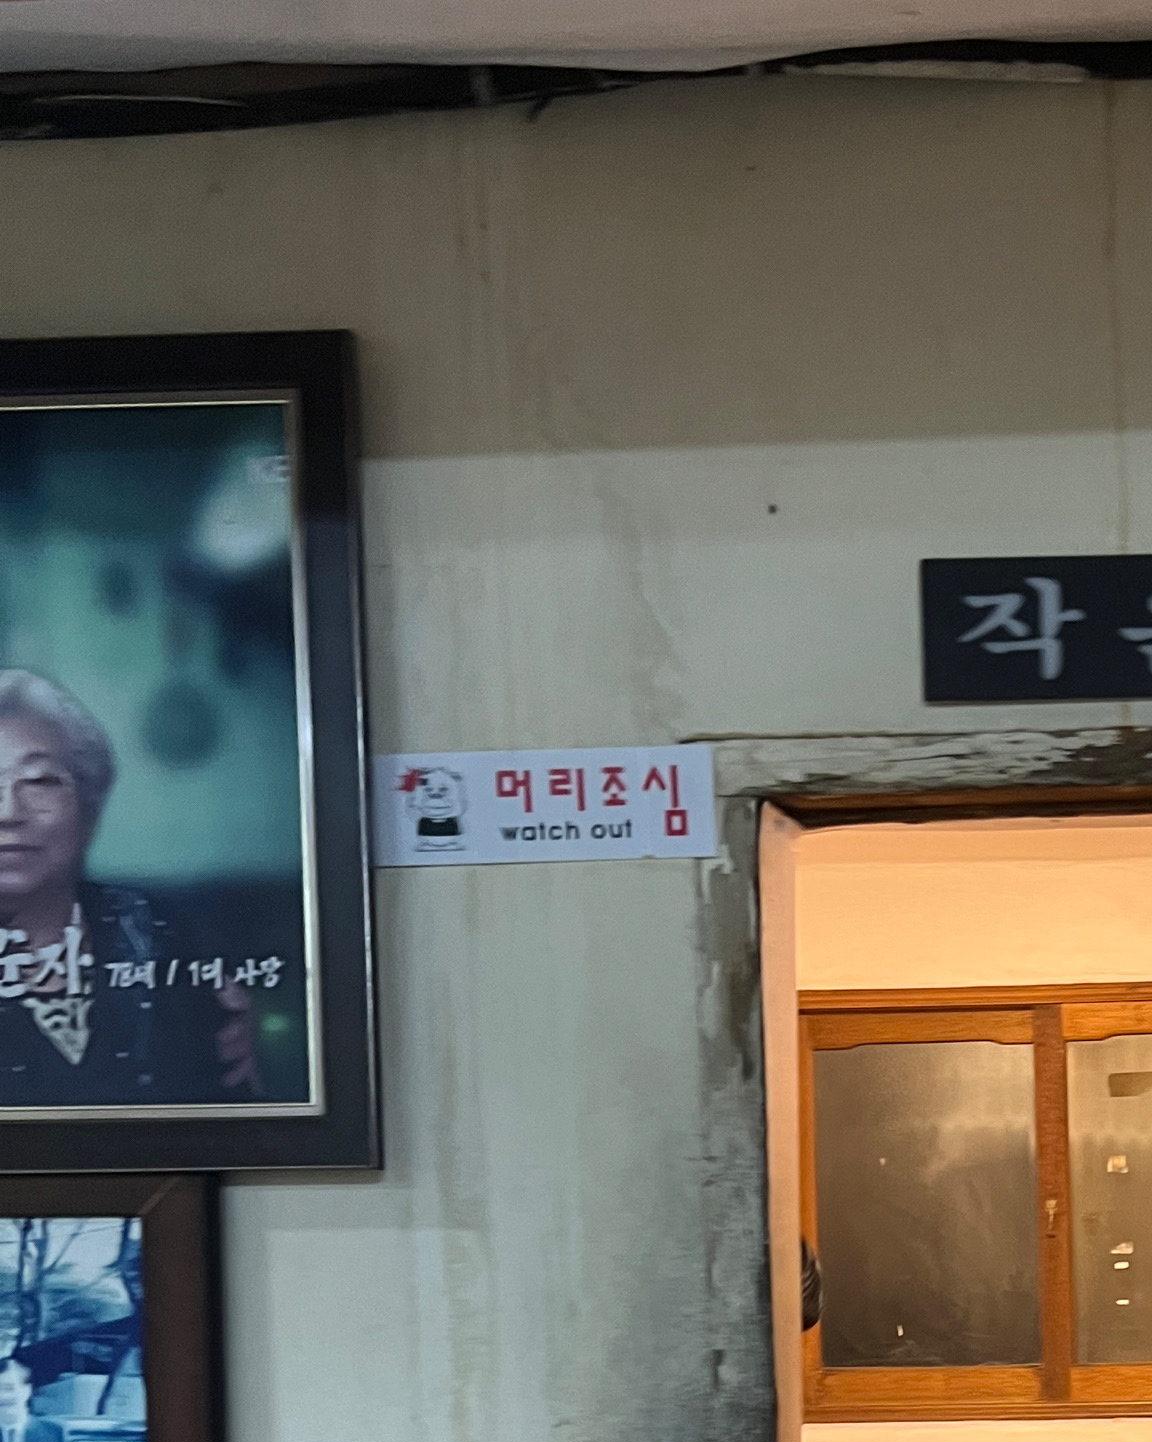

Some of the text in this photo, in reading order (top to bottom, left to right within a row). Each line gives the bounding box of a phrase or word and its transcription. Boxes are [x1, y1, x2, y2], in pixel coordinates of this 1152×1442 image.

[495, 765, 690, 836] 머리조심
[500, 820, 633, 841] watch out
